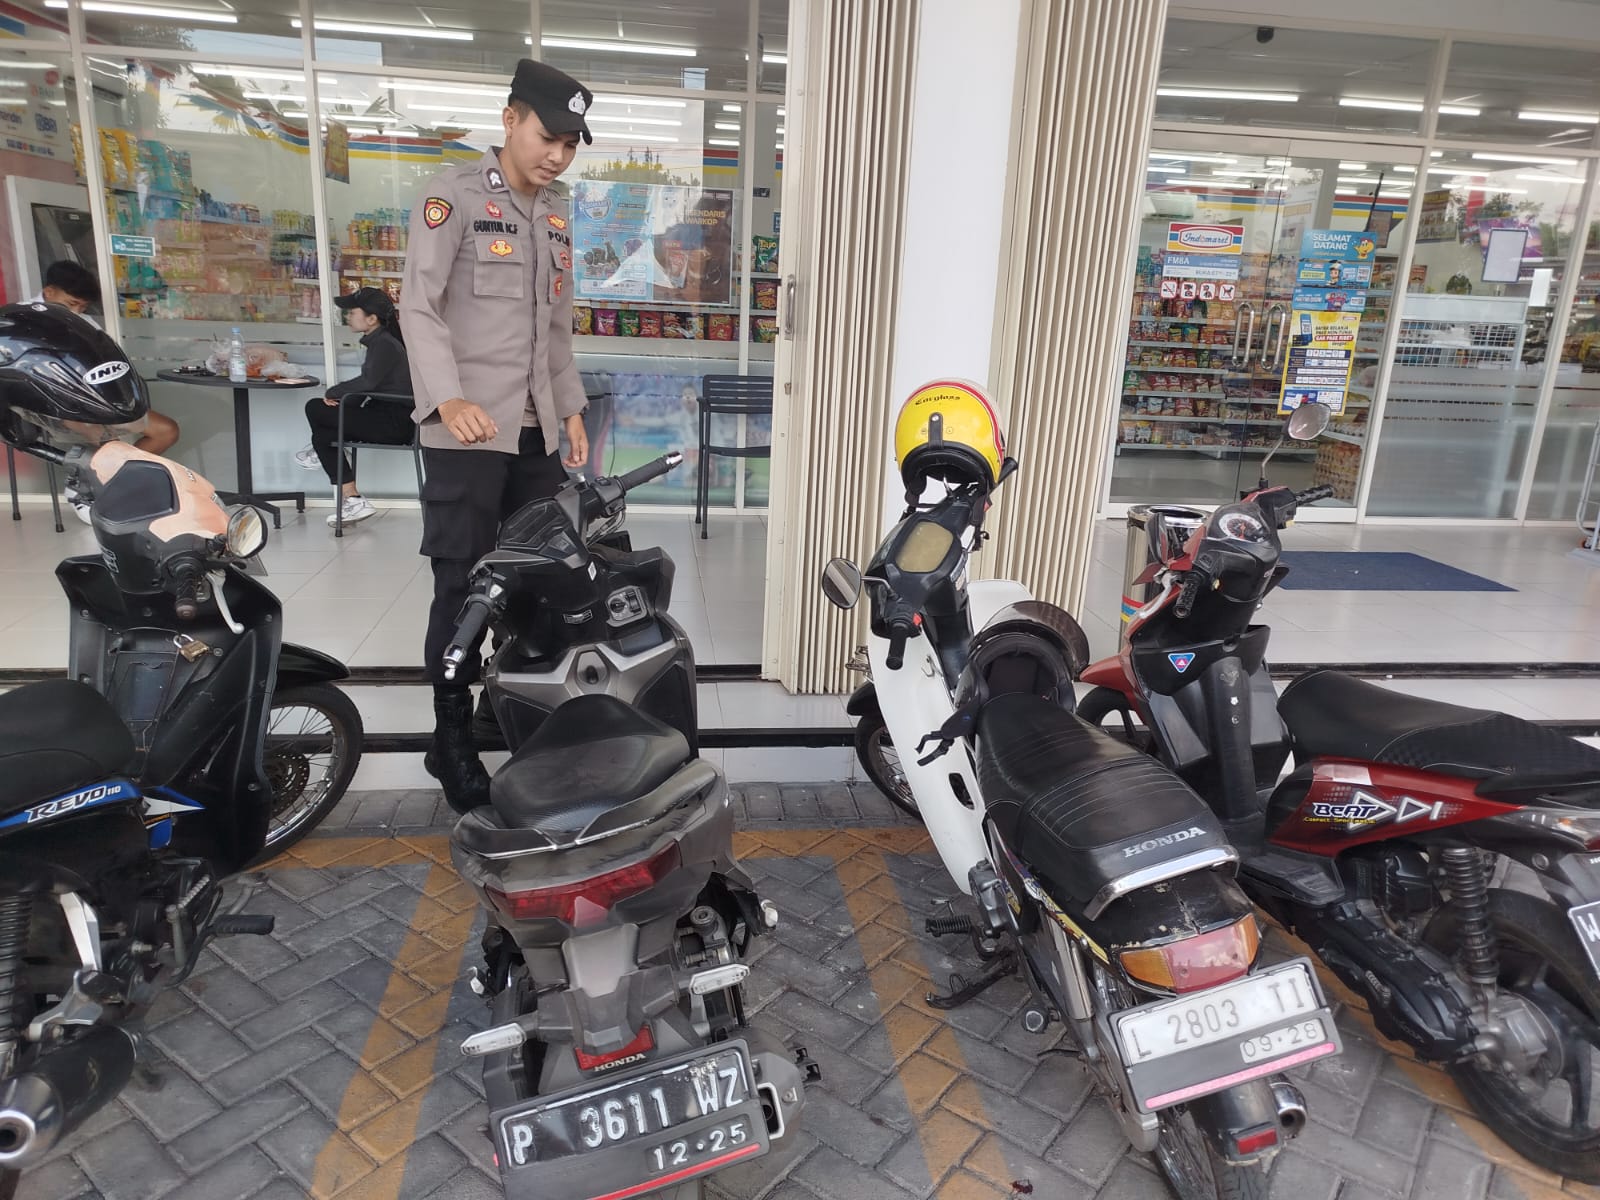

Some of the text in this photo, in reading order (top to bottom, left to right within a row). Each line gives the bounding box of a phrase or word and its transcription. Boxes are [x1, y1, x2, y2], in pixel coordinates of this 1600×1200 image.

[1182, 232, 1229, 244] Indomaret
[1312, 233, 1352, 243] SELAMAT
[1312, 241, 1348, 250] DATANG
[90, 364, 122, 381] INK
[25, 785, 121, 823] REVO 110
[1124, 826, 1207, 858] HONDA
[1132, 977, 1304, 1059] L 2803 TI
[594, 1051, 646, 1072] HONDA
[512, 1066, 743, 1165] P 3611 WZ
